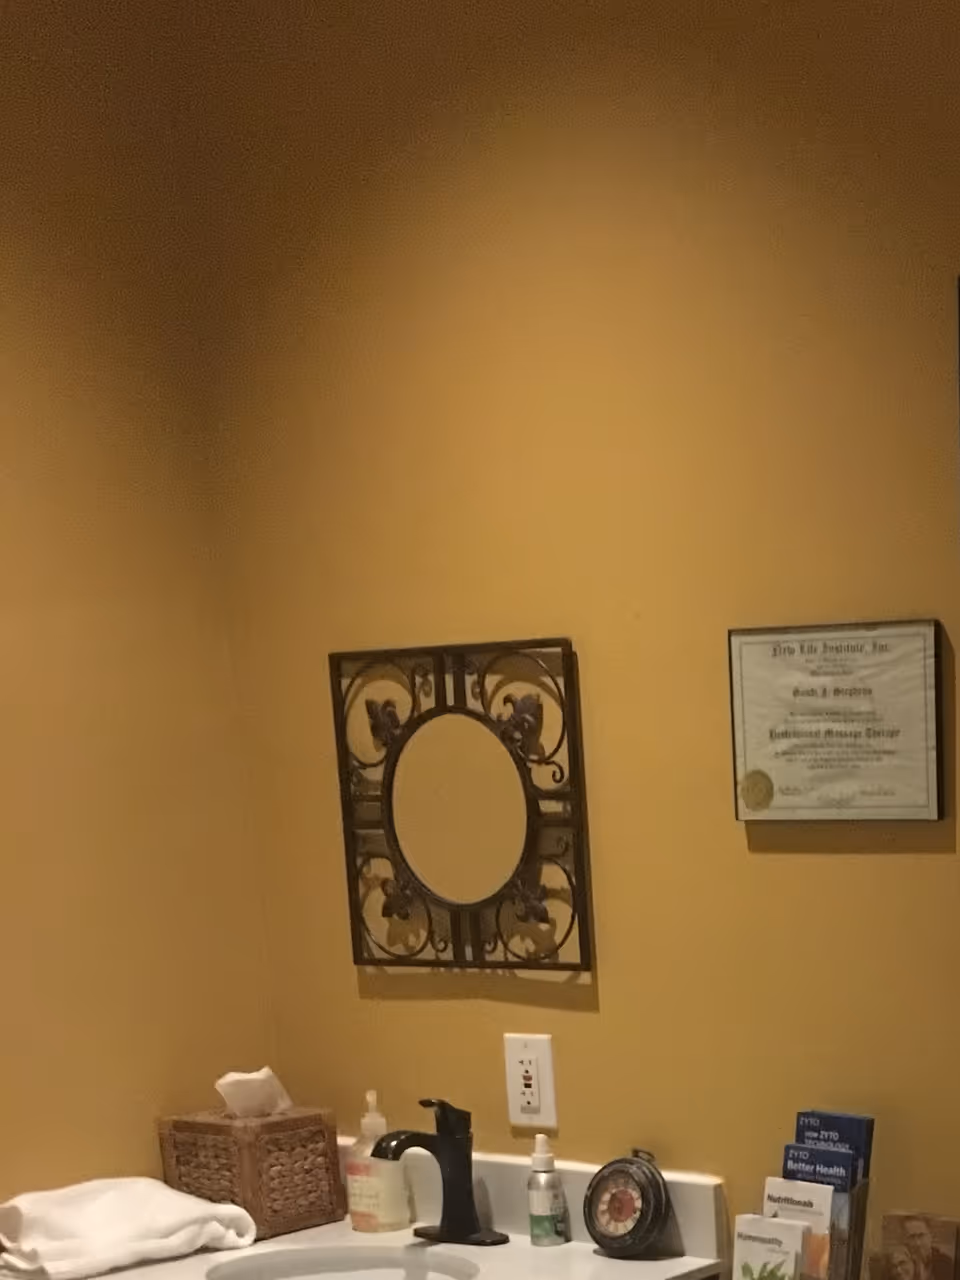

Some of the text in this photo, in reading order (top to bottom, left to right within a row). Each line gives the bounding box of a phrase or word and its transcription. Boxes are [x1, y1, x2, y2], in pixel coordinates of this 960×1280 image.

[799, 1117, 820, 1127] ZYTO
[819, 1130, 840, 1141] ZYTO
[789, 1150, 809, 1160] ZYTO
[787, 1159, 847, 1178] Better Health
[767, 1193, 814, 1209] Nutritionals
